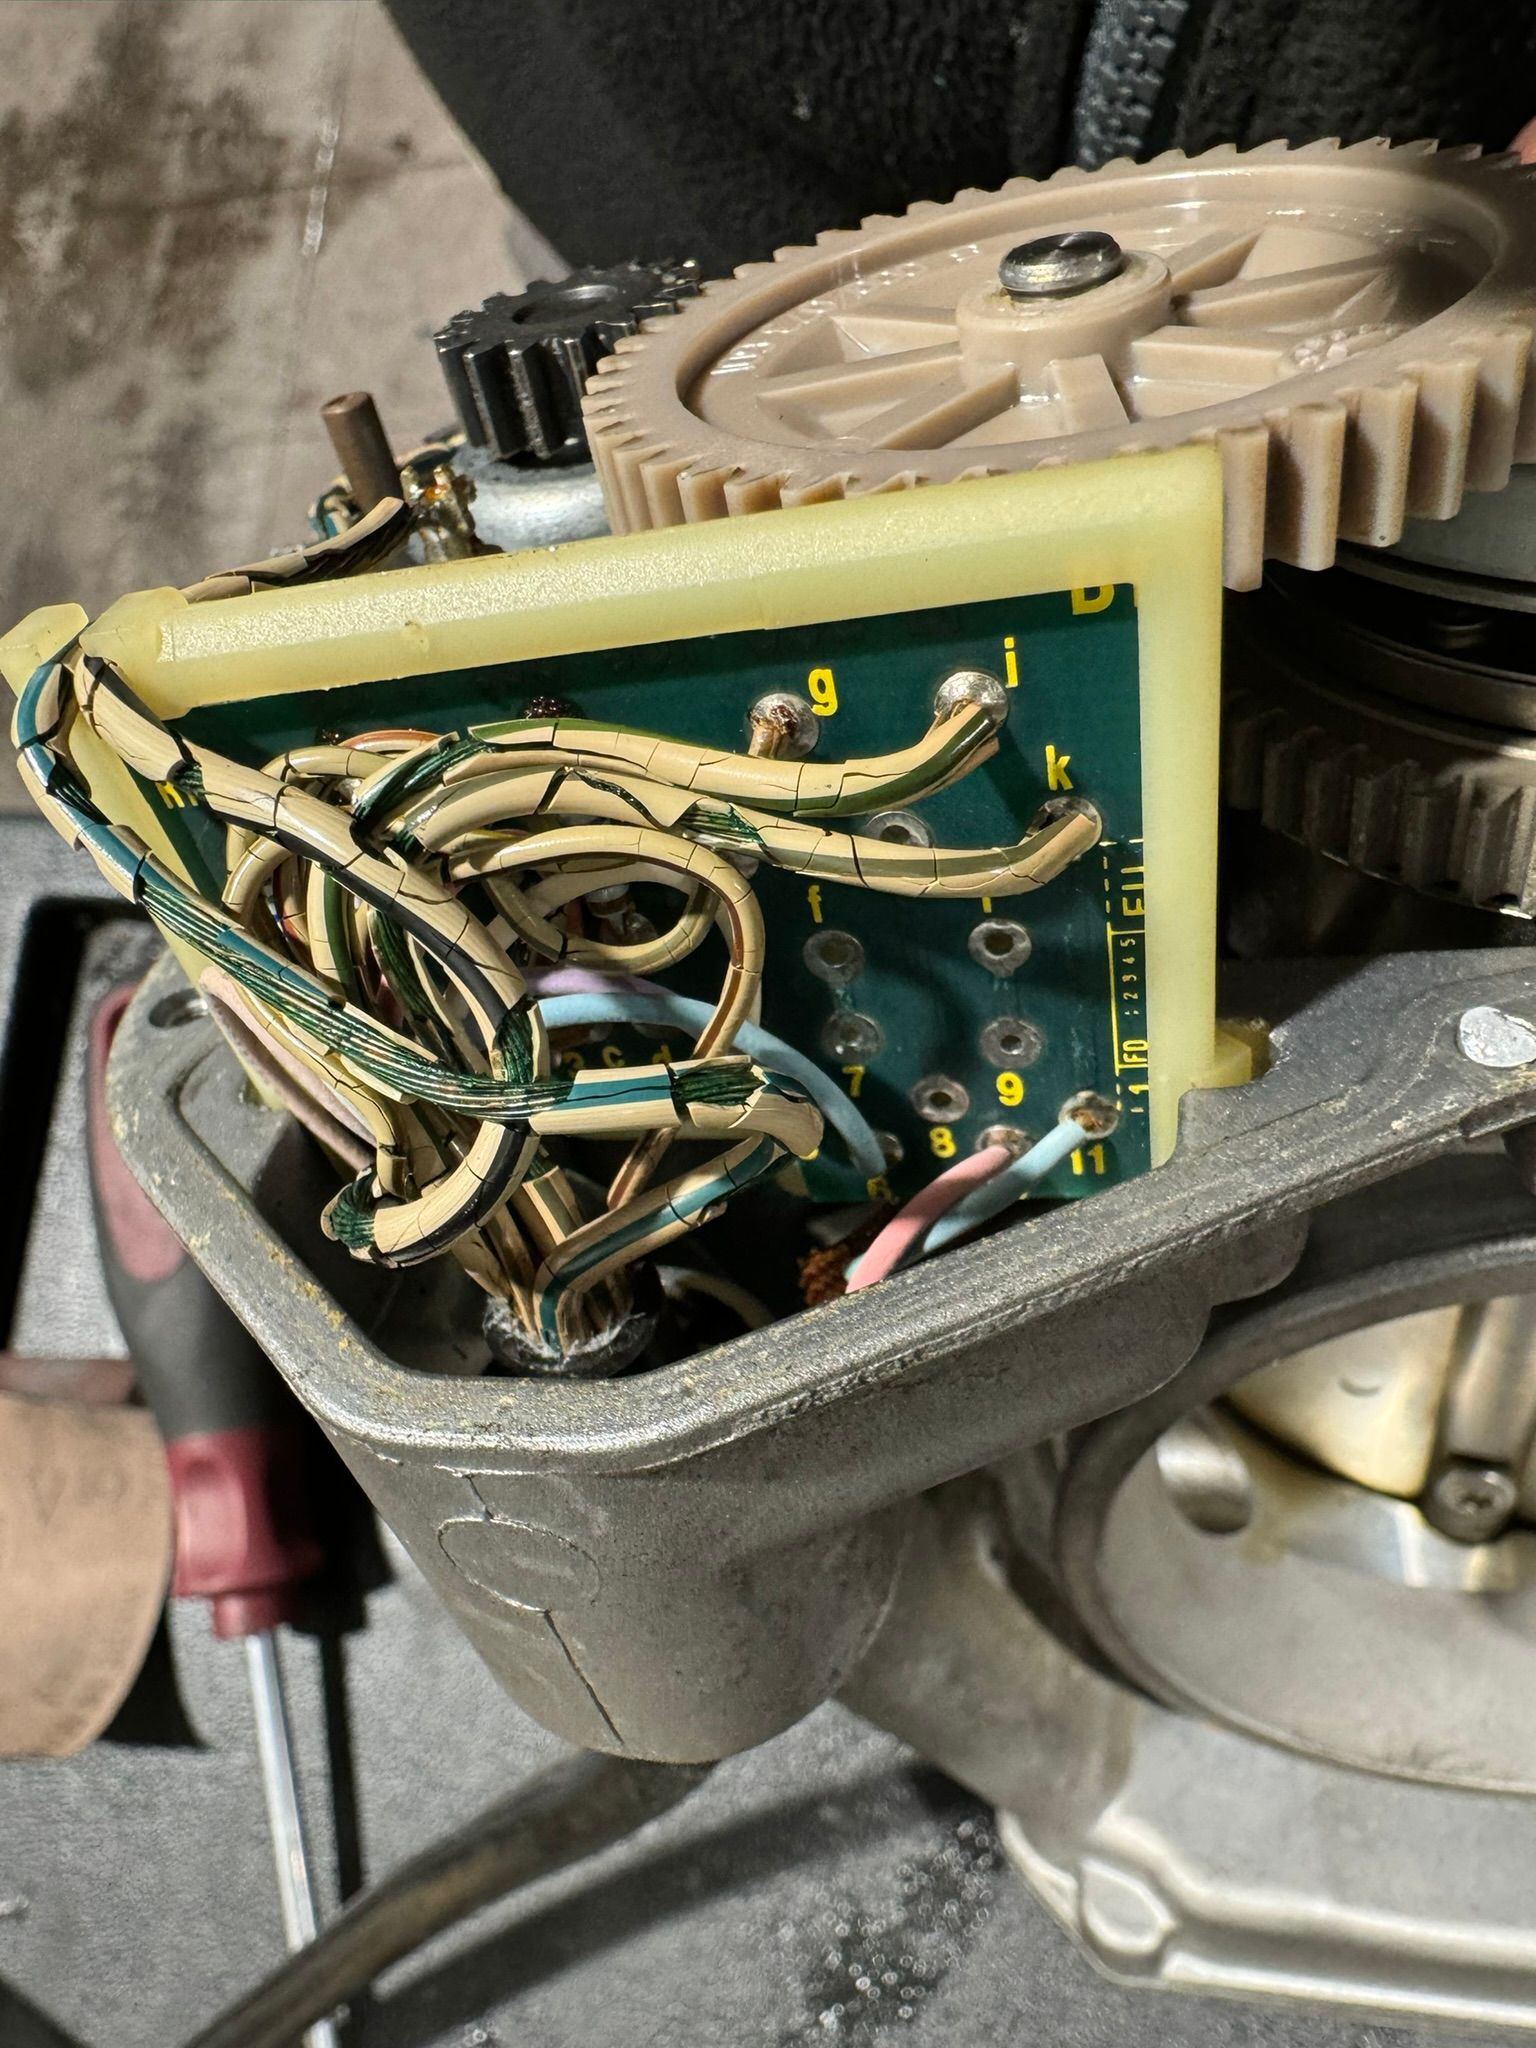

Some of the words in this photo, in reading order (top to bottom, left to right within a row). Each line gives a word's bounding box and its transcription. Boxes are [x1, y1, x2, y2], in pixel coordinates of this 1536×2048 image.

[807, 668, 838, 716] g
[1045, 745, 1073, 790] k
[807, 885, 823, 923] f
[842, 1066, 865, 1097] 7
[996, 1072, 1024, 1106] 9
[929, 1127, 957, 1158] 8
[1070, 1144, 1105, 1176] 11
